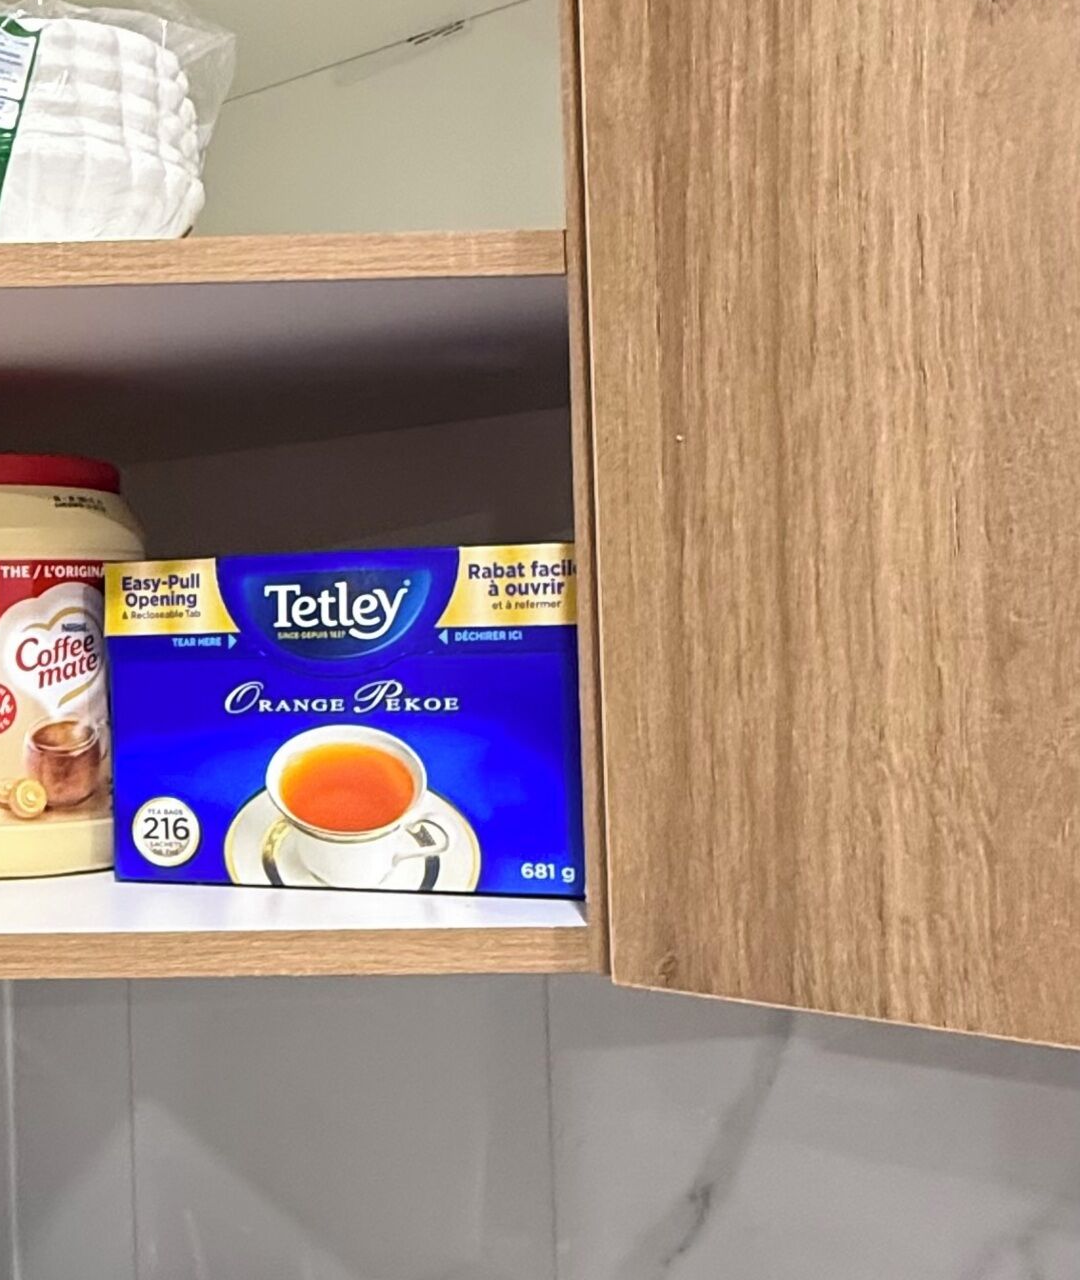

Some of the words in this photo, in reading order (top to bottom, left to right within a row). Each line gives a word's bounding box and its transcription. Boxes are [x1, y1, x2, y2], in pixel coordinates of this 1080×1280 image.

[0, 565, 30, 579] THE
[468, 562, 525, 579] Rabat
[122, 573, 200, 592] Easy-Pull
[488, 580, 499, 596] à
[505, 578, 565, 596] ouvrir
[125, 591, 197, 609] Opening
[264, 580, 408, 640] Tetley
[172, 637, 196, 648] TEAR
[15, 634, 95, 671] Coffee
[38, 653, 98, 688] mate
[143, 817, 190, 840] 216
[521, 862, 555, 880] 681
[561, 866, 576, 883] g
